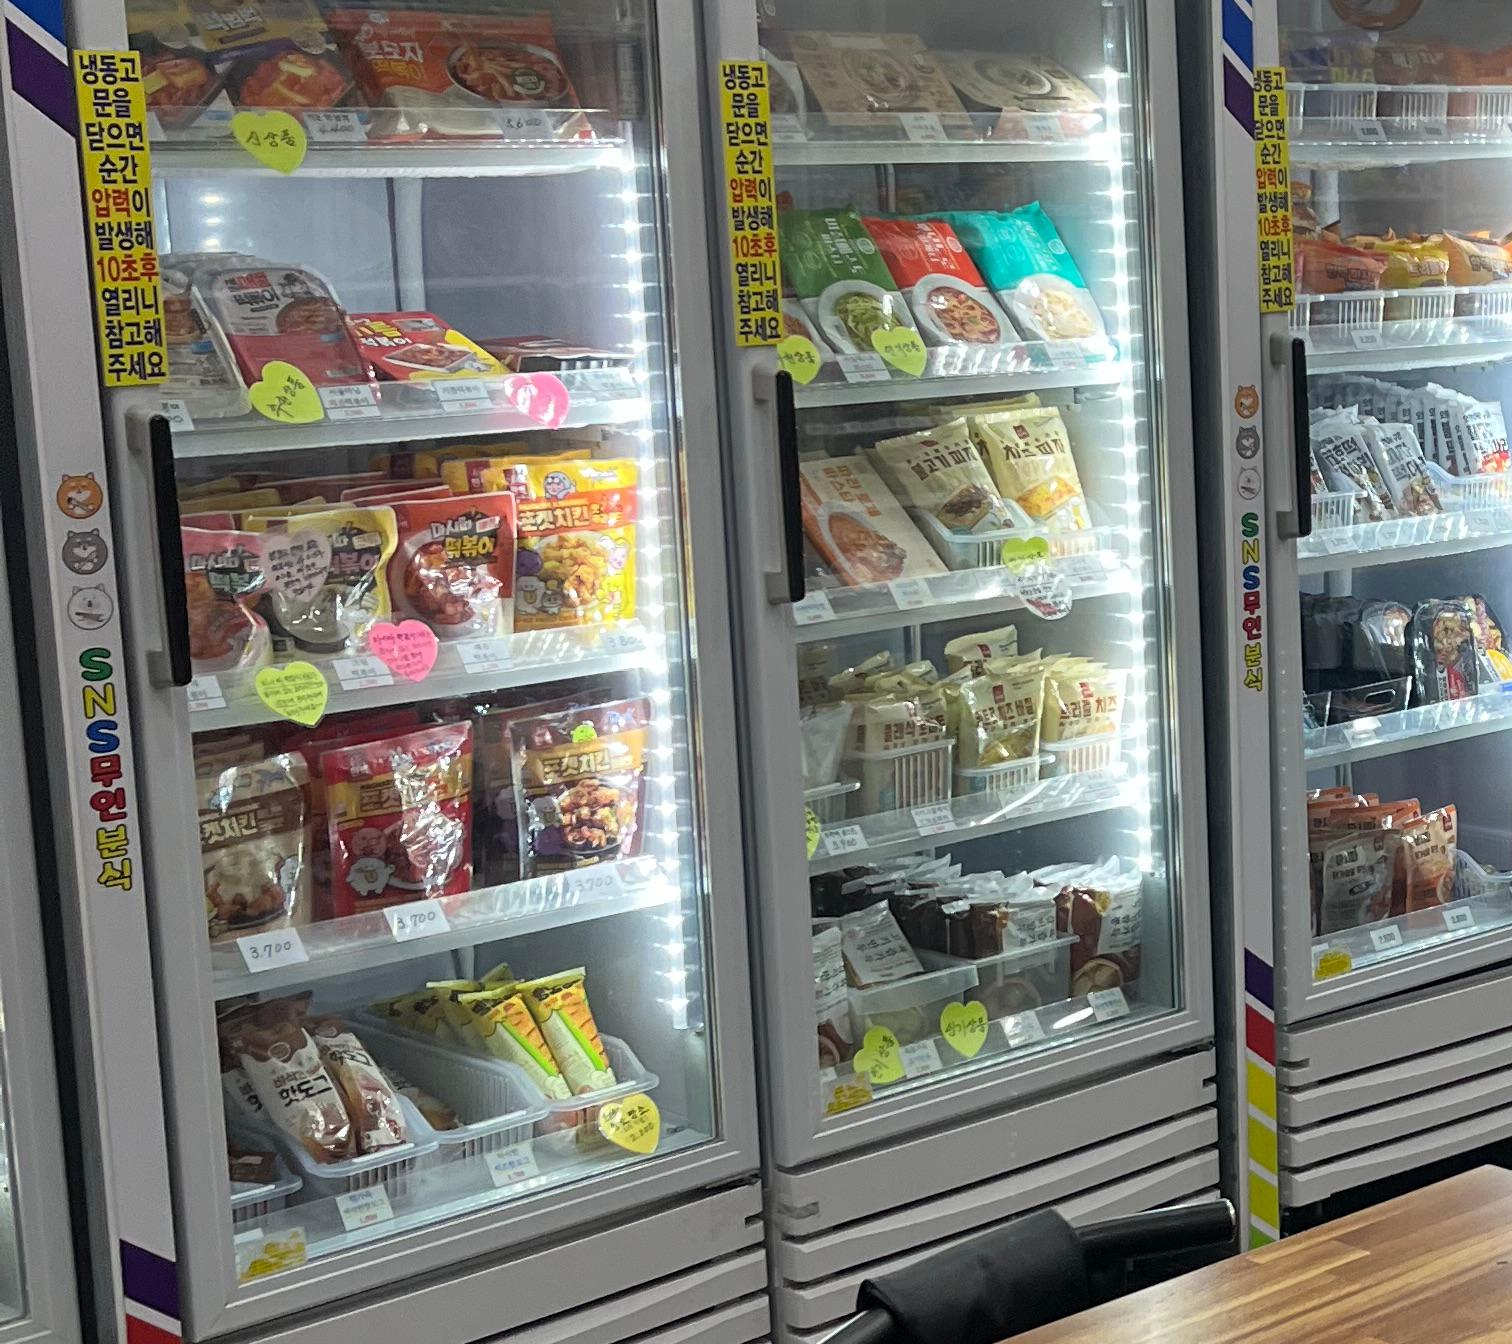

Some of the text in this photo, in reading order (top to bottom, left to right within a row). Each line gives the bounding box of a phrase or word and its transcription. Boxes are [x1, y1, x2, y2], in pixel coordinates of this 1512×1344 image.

[79, 54, 139, 84] 냉동고
[722, 63, 766, 90] 냉동고
[93, 88, 131, 118] 문을
[732, 92, 759, 118] 문을
[1258, 94, 1280, 116] 문을
[85, 122, 144, 151] 닫으면
[726, 122, 768, 147] 닫으면
[735, 149, 763, 175] 순간
[1260, 143, 1282, 165] 순간
[99, 155, 138, 184] 순간
[1256, 168, 1288, 189] 압력이
[92, 188, 151, 217] 압력이
[730, 177, 772, 204] 압력이
[1257, 192, 1289, 214] 발생해
[732, 206, 773, 231] 발생해
[1258, 214, 1291, 237] 10초후
[95, 221, 153, 250] 발생해
[732, 233, 778, 258] 10초후
[1260, 239, 1291, 261] 열리니
[97, 254, 160, 283] 10초후
[736, 261, 777, 286] 열리니
[1261, 263, 1292, 285] 참고해
[101, 286, 160, 316] 열리니
[737, 288, 780, 314] 참고해
[1262, 288, 1294, 309] 주세요
[105, 319, 163, 349] 참고해
[740, 317, 782, 343] 주세요
[108, 353, 167, 381] 주세요
[1241, 512, 1263, 692] SNS 무인분식
[78, 646, 133, 892] SNS 무인분식
